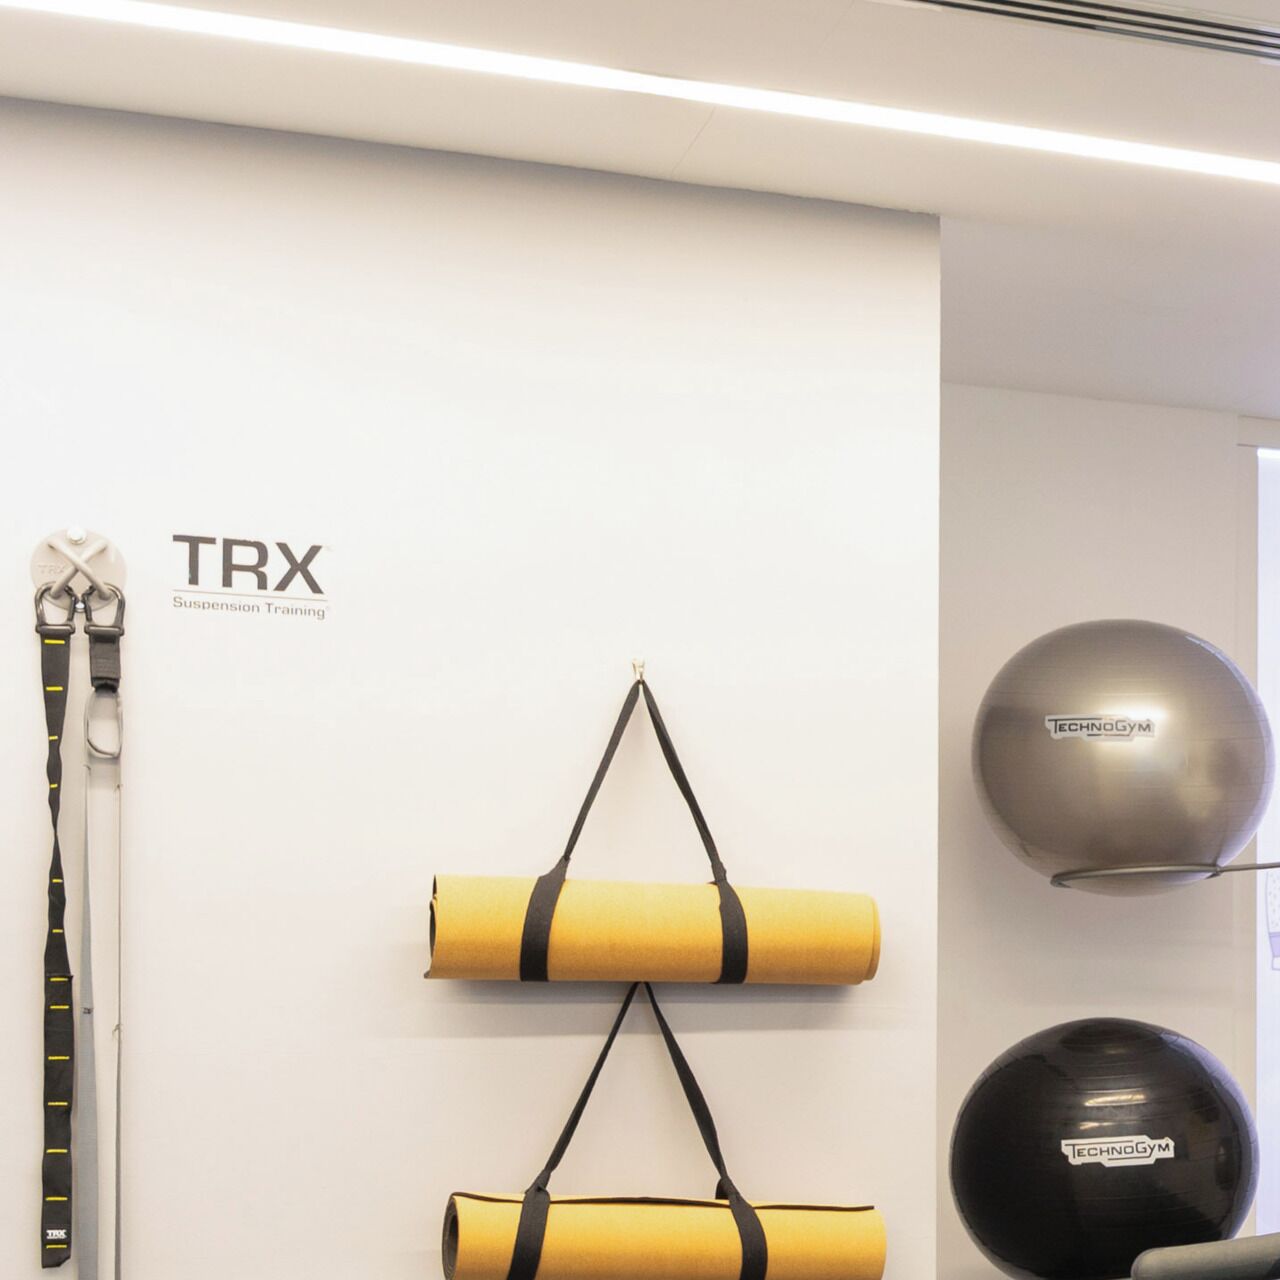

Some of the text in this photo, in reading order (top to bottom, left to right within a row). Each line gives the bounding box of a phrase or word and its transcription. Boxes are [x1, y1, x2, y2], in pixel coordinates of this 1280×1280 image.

[172, 534, 324, 595] TRX
[172, 596, 325, 620] Suspension Training
[1065, 1140, 1170, 1161] TECHNOGYM
